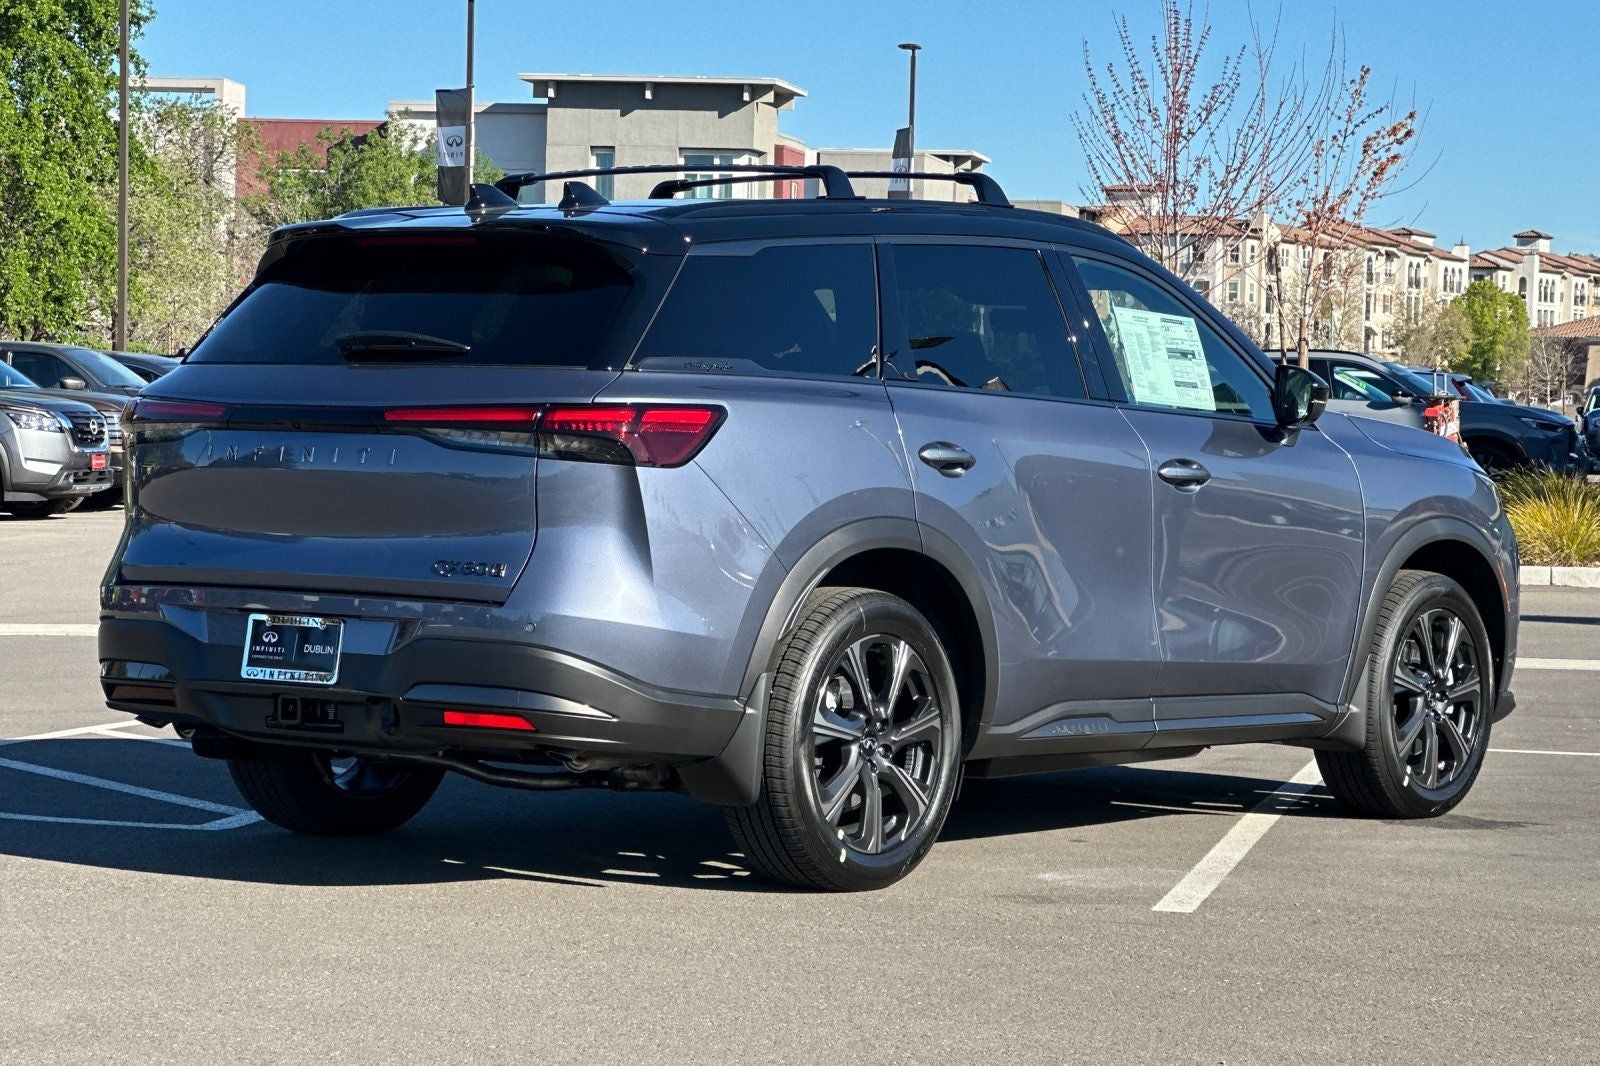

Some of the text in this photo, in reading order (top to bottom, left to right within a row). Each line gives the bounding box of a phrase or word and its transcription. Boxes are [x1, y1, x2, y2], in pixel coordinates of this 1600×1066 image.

[206, 444, 398, 465] INFINITI
[252, 645, 285, 653] INFINITI
[303, 644, 334, 655] DUBLIN
